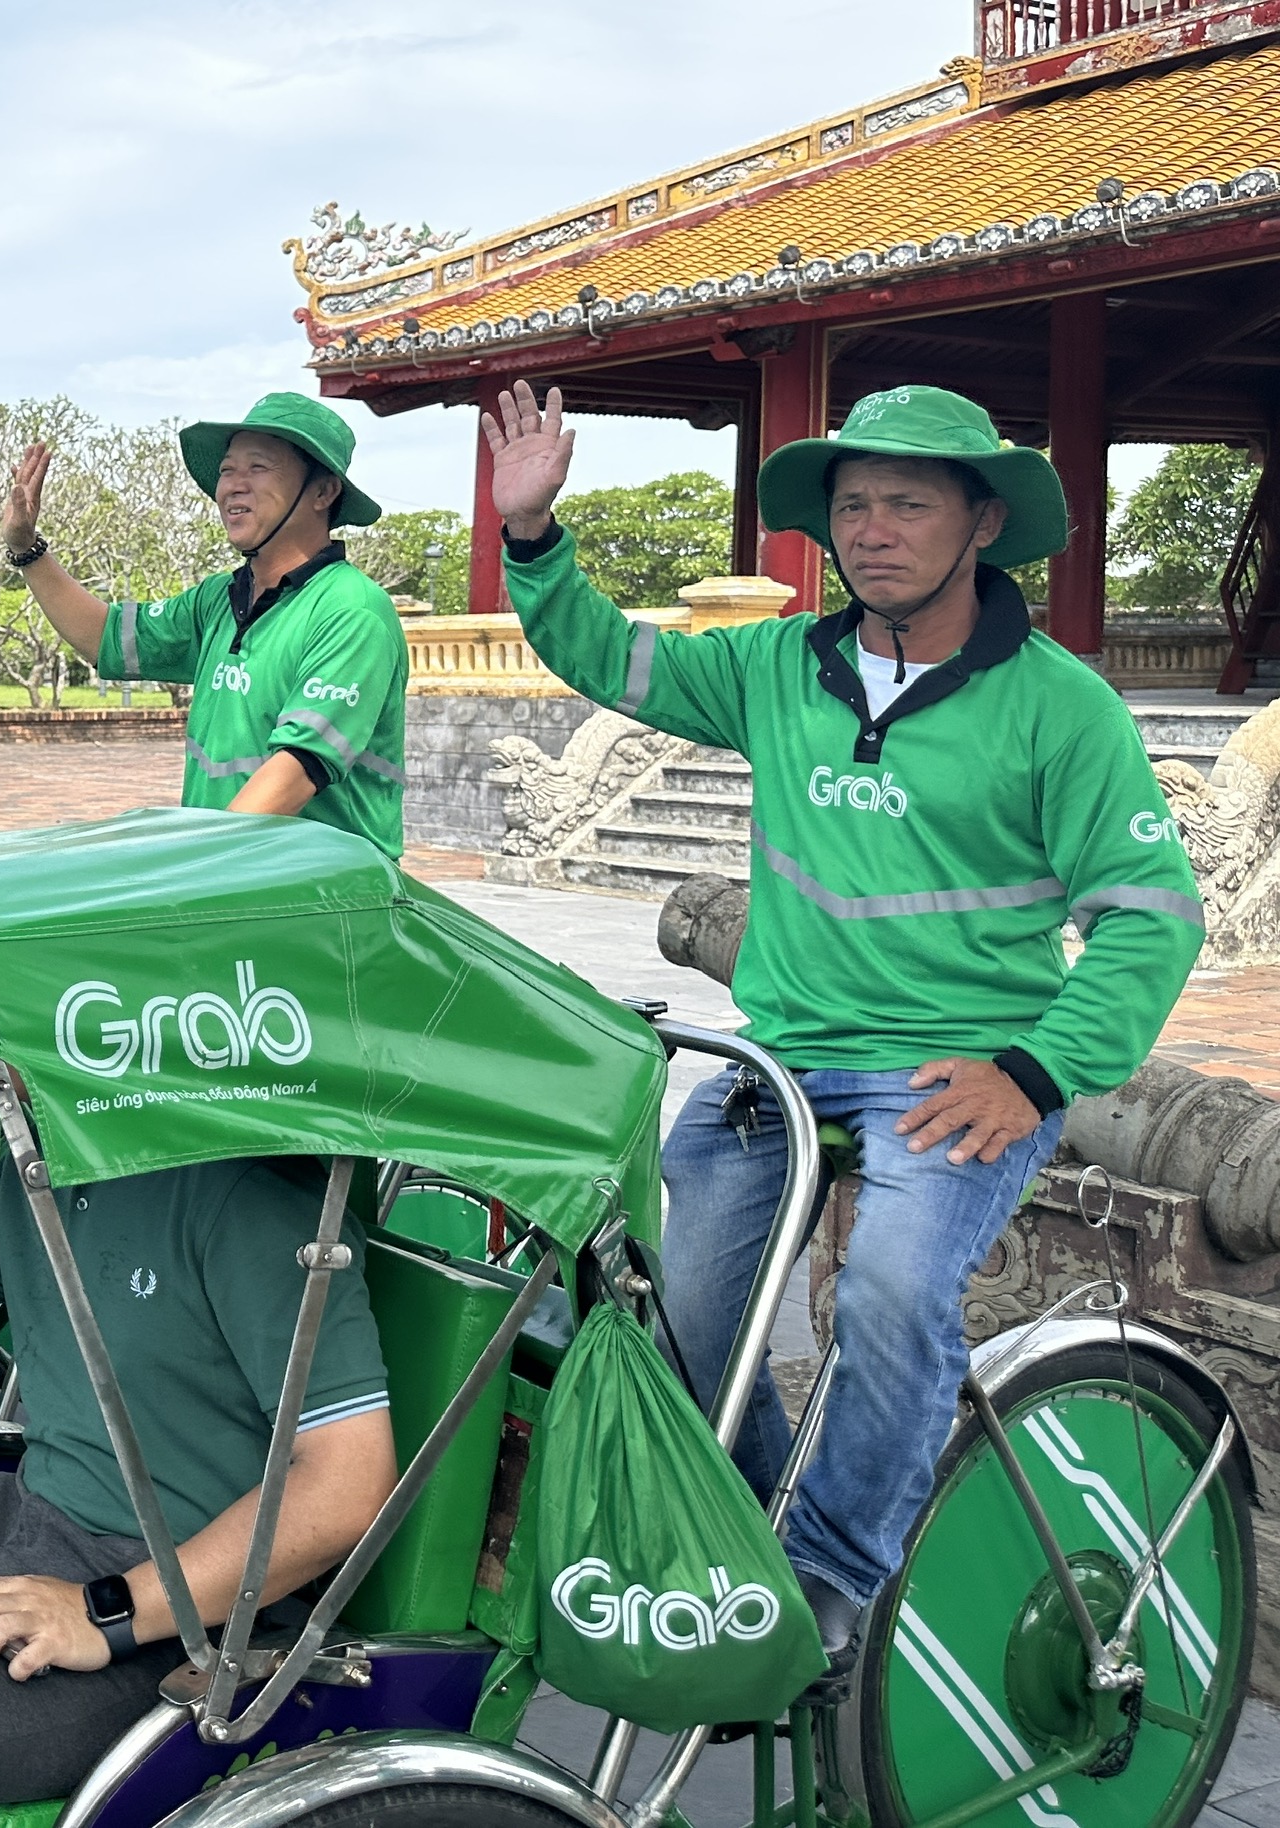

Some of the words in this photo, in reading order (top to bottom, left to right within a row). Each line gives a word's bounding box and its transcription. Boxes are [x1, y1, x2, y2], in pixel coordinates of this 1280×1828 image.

[211, 661, 251, 696] Grab
[302, 677, 360, 707] Grab
[808, 765, 907, 818] Grab
[54, 959, 313, 1078] Grab
[76, 1097, 109, 1115] Siêu
[113, 1093, 143, 1109] ứng
[145, 1089, 180, 1104] dụng
[233, 1084, 269, 1101] Đông
[272, 1083, 304, 1096] Nam
[306, 1079, 318, 1094] Á
[551, 1557, 780, 1650] Grab
